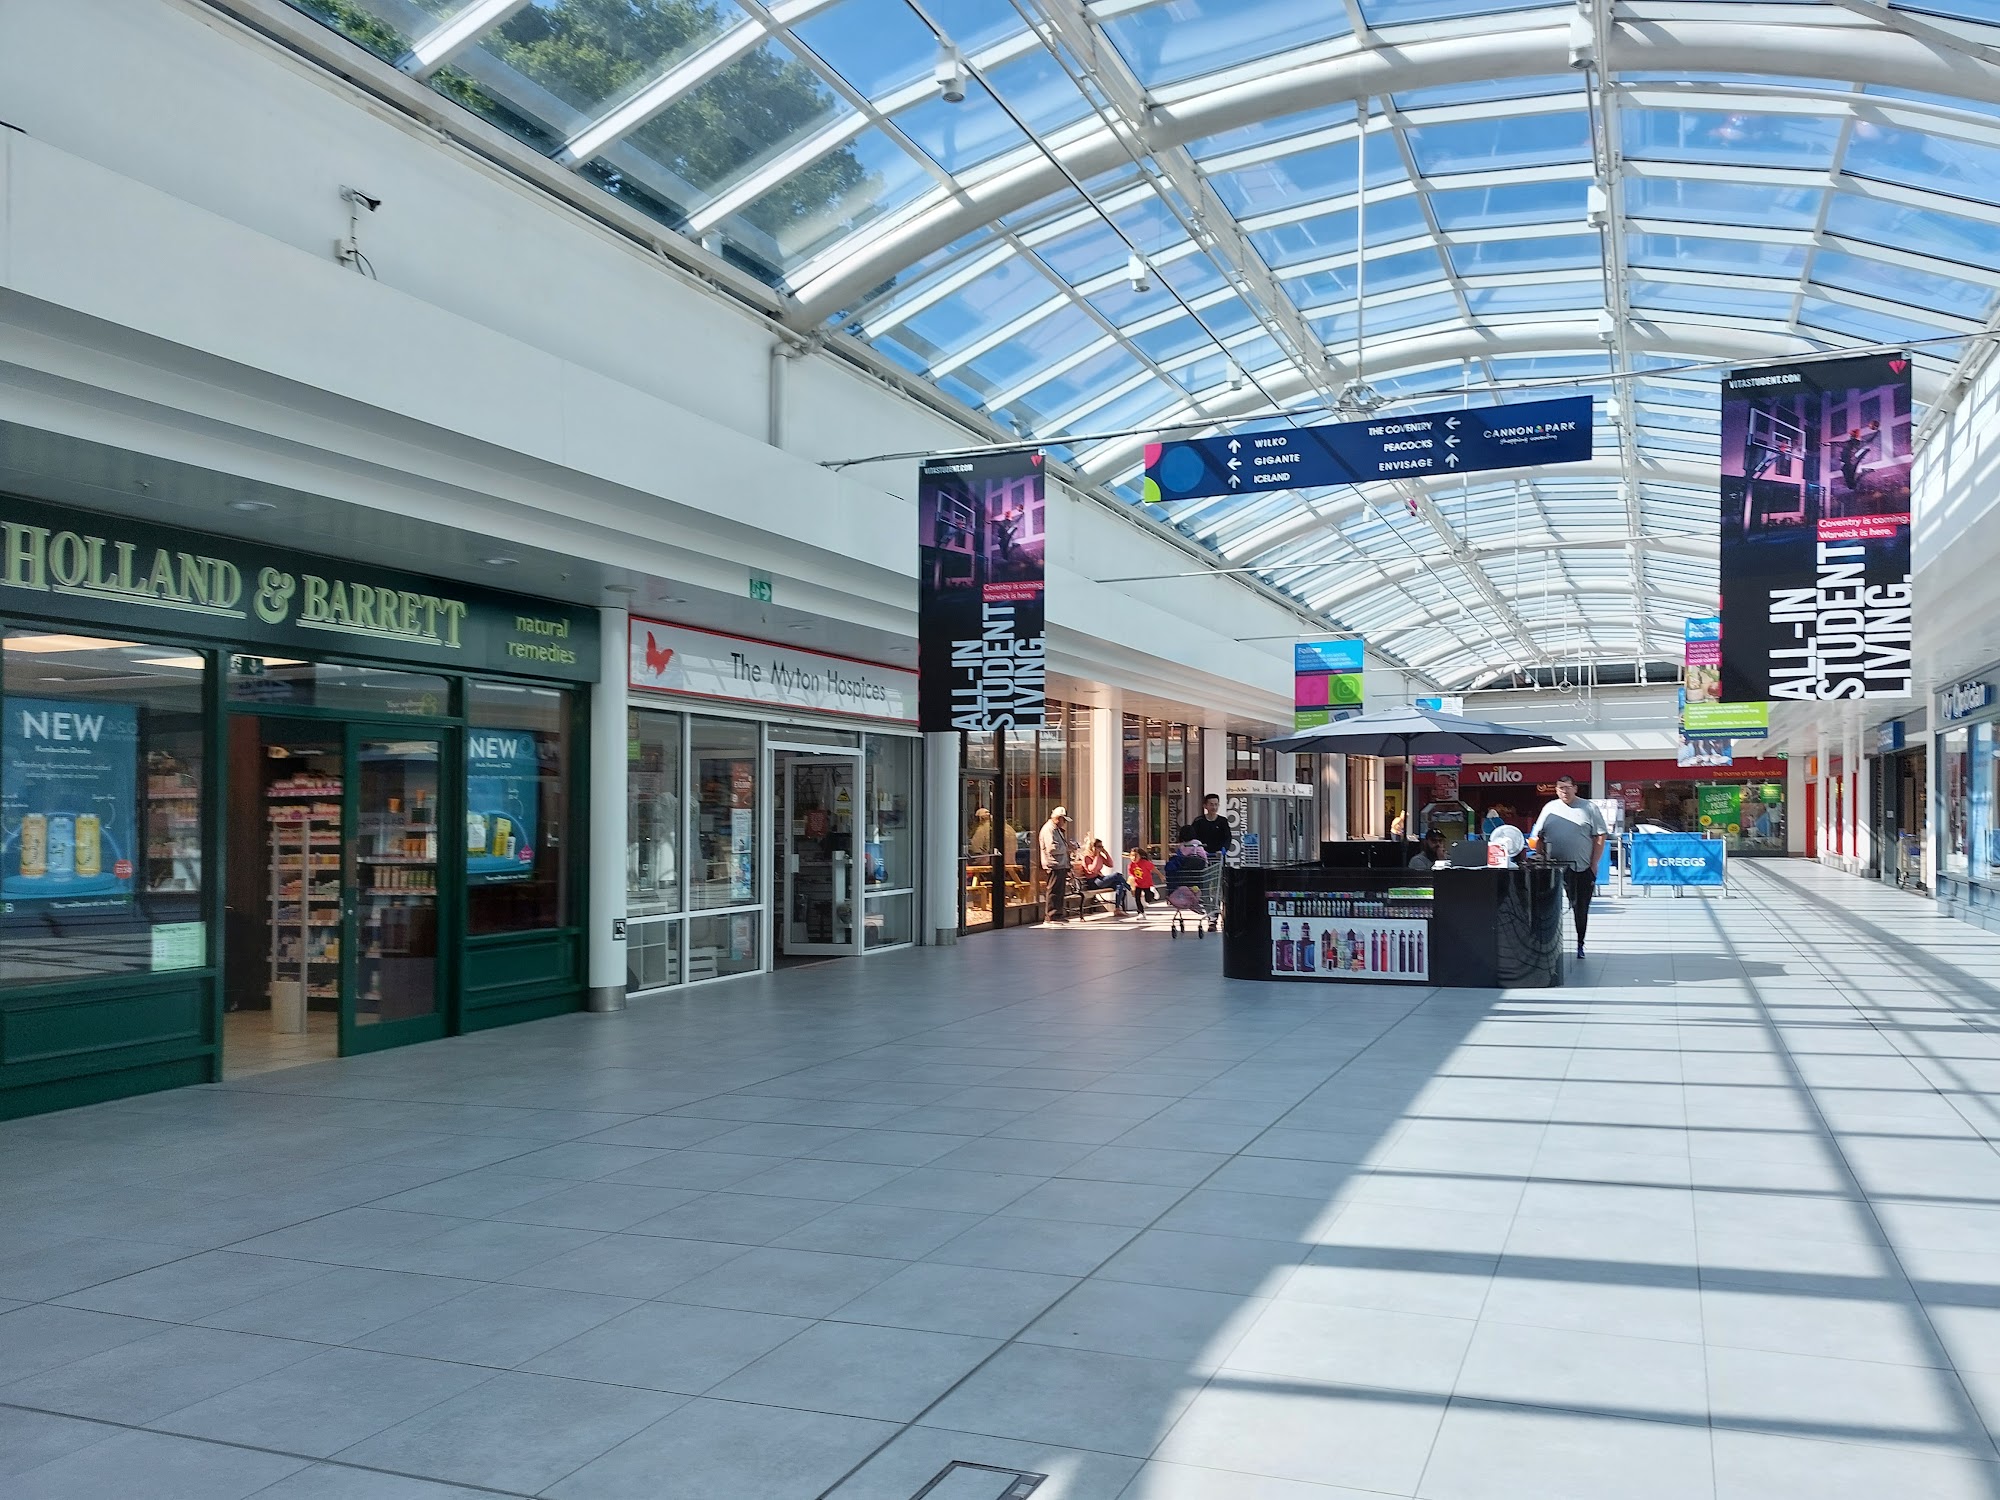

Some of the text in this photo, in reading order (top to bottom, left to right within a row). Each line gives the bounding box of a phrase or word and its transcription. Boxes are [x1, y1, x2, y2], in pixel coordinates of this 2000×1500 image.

[1729, 373, 1801, 389] VITASTUDENT.COM
[1368, 421, 1433, 436] THE COVENTRY
[1483, 426, 1534, 439] CANNON
[1545, 421, 1576, 432] PARK
[1254, 437, 1287, 448] WILKO
[1384, 440, 1433, 452] PEACOCKS
[1254, 453, 1300, 466] GIGANTE
[1379, 458, 1433, 471] ENVISAGE
[1254, 472, 1290, 484] ICELAND
[1819, 514, 1910, 528] Coventry is coming.
[1819, 526, 1892, 539] Warwick is here.
[0, 520, 466, 648] HOLLAND & BARRETT
[983, 583, 1012, 592] Coventry
[515, 614, 569, 639] natural
[1816, 542, 1865, 700] STUDENT
[1769, 588, 1817, 700] ALL-IN
[1864, 574, 1912, 698] LIVING.
[507, 639, 577, 665] remedies
[982, 603, 1015, 731] STUDENT
[730, 652, 886, 703] The Myton Hospices
[951, 640, 983, 731] ALL-IN
[1014, 631, 1046, 730] LIVING.
[23, 709, 104, 742] NEW
[469, 736, 518, 759] NEW
[1478, 766, 1523, 783] wilko
[1659, 857, 1706, 867] GREGGS
